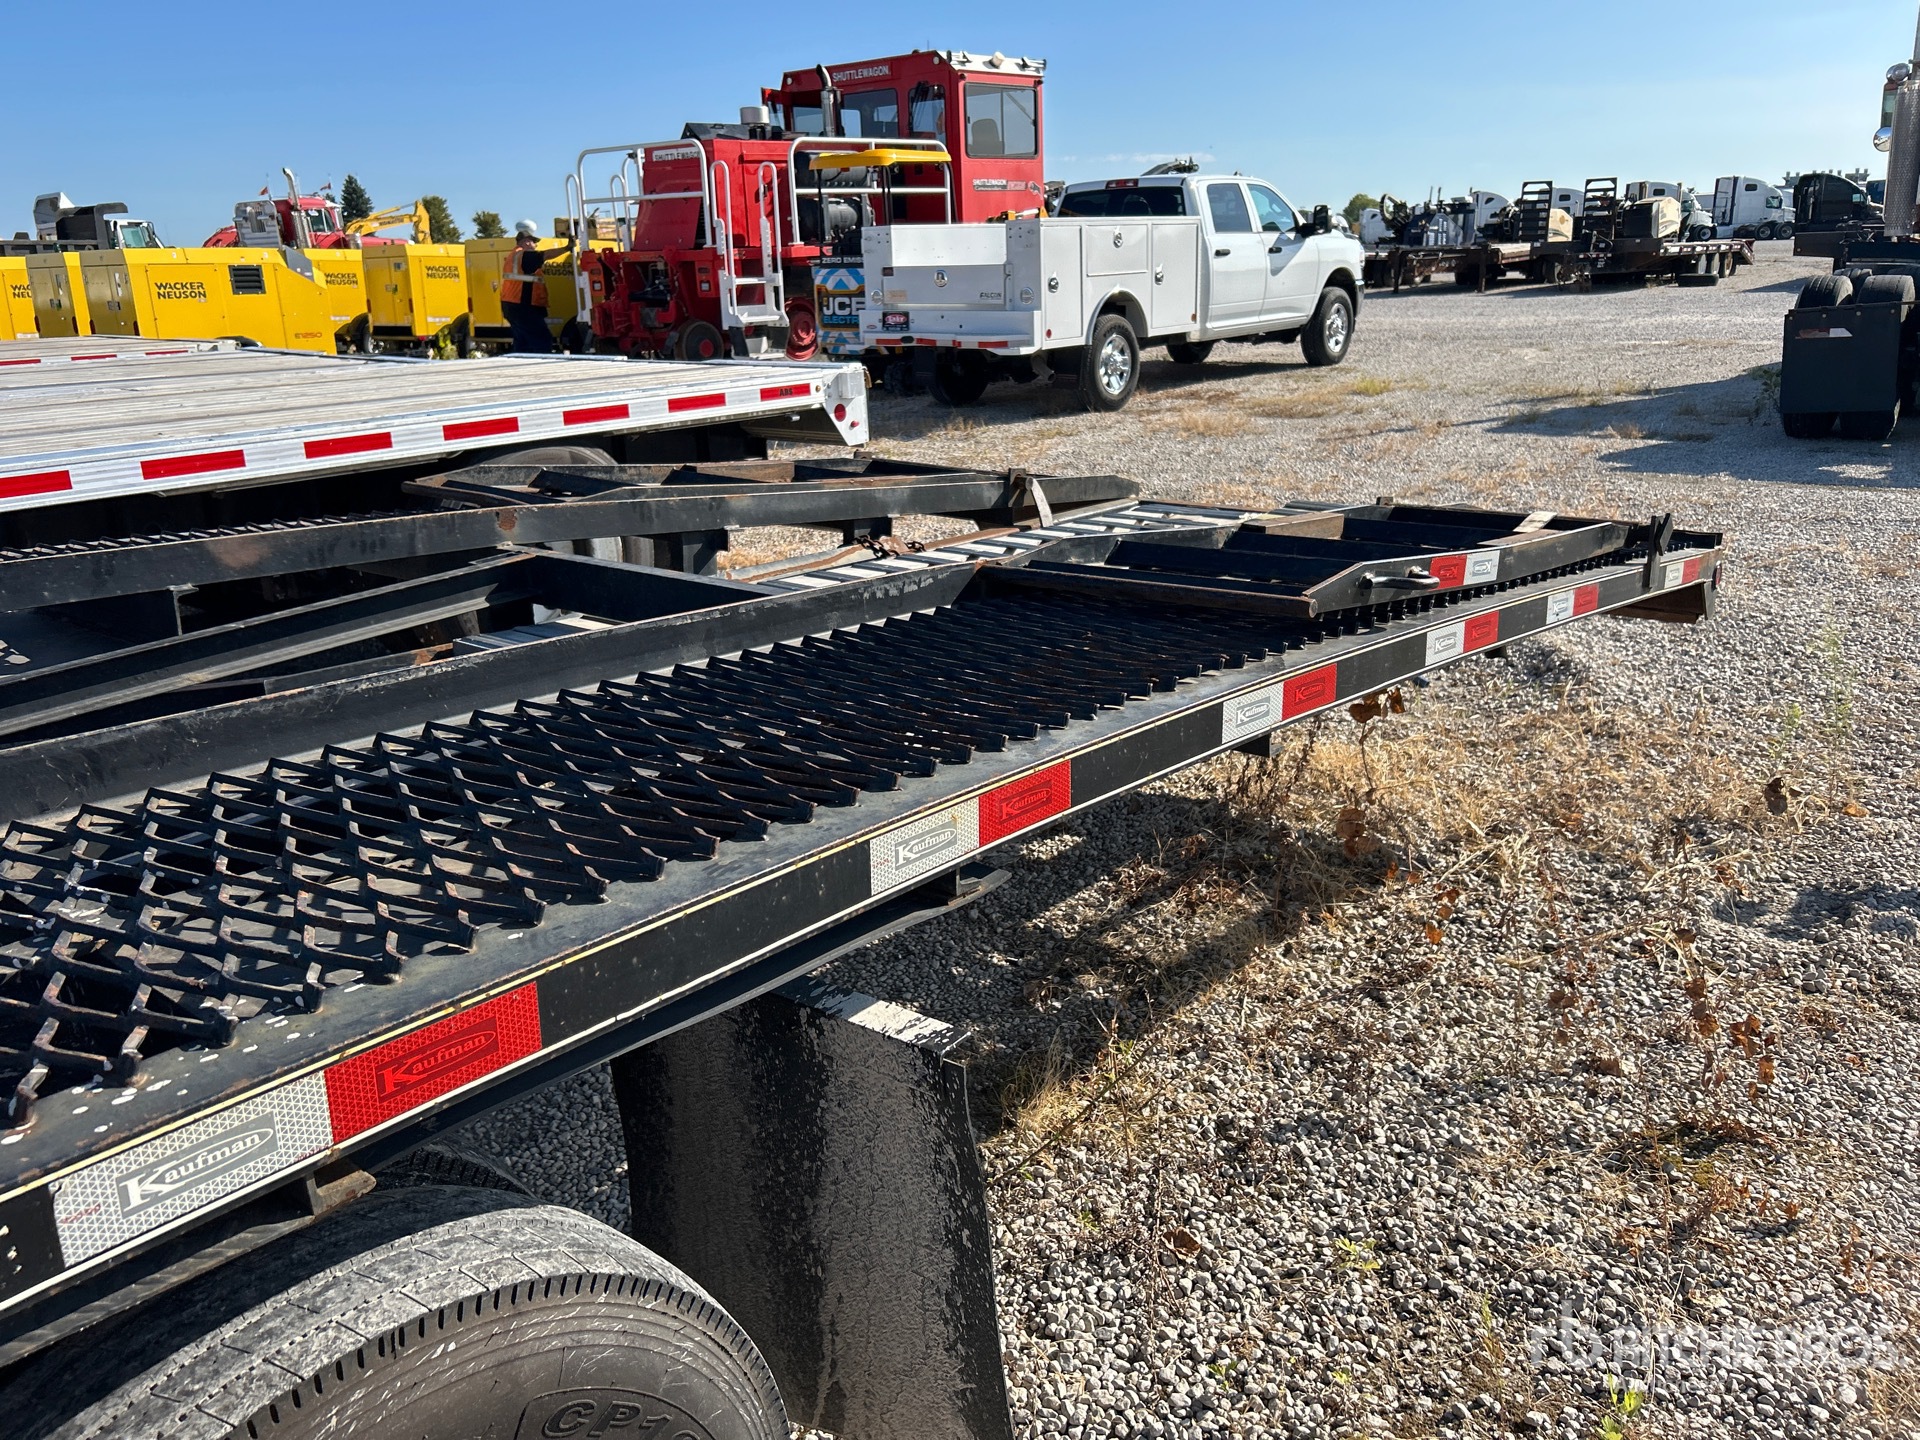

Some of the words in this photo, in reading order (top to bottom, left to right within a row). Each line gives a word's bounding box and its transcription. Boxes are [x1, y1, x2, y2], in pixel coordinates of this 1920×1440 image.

[832, 65, 889, 82] SHUTTLEWAGON
[425, 265, 459, 273] WACKER
[324, 272, 357, 280] WACKER
[426, 272, 460, 280] NEUSON
[154, 282, 205, 291] WACKER
[157, 290, 207, 300] NEUSON
[779, 388, 793, 397] ABS
[1000, 788, 1050, 821] Kaufman
[896, 828, 956, 867] Kaufman
[377, 1031, 496, 1097] Kaufman
[119, 1129, 273, 1212] Kaufman
[541, 1399, 701, 1440] CP1
